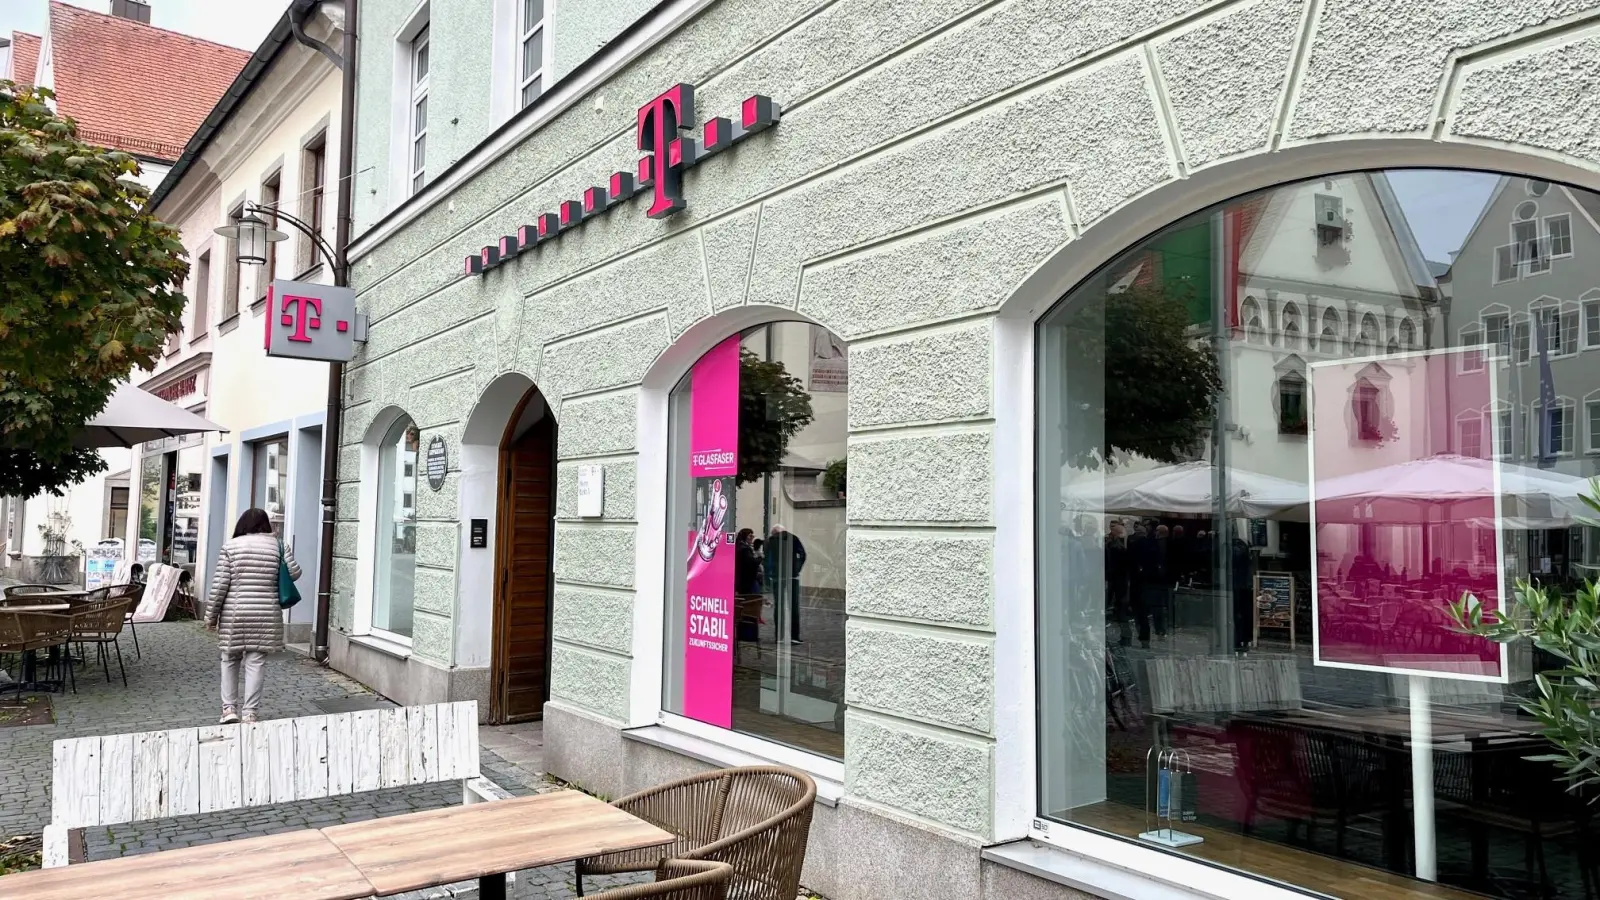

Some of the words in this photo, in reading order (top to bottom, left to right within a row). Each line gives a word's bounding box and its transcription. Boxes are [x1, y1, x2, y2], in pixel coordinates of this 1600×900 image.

[637, 82, 695, 219] T
[281, 294, 323, 343] T
[698, 452, 735, 466] GLASFASER
[690, 595, 729, 615] SCHNELL
[689, 613, 729, 640] STABIL
[688, 637, 728, 653] ZUKUNFTSSICHER
